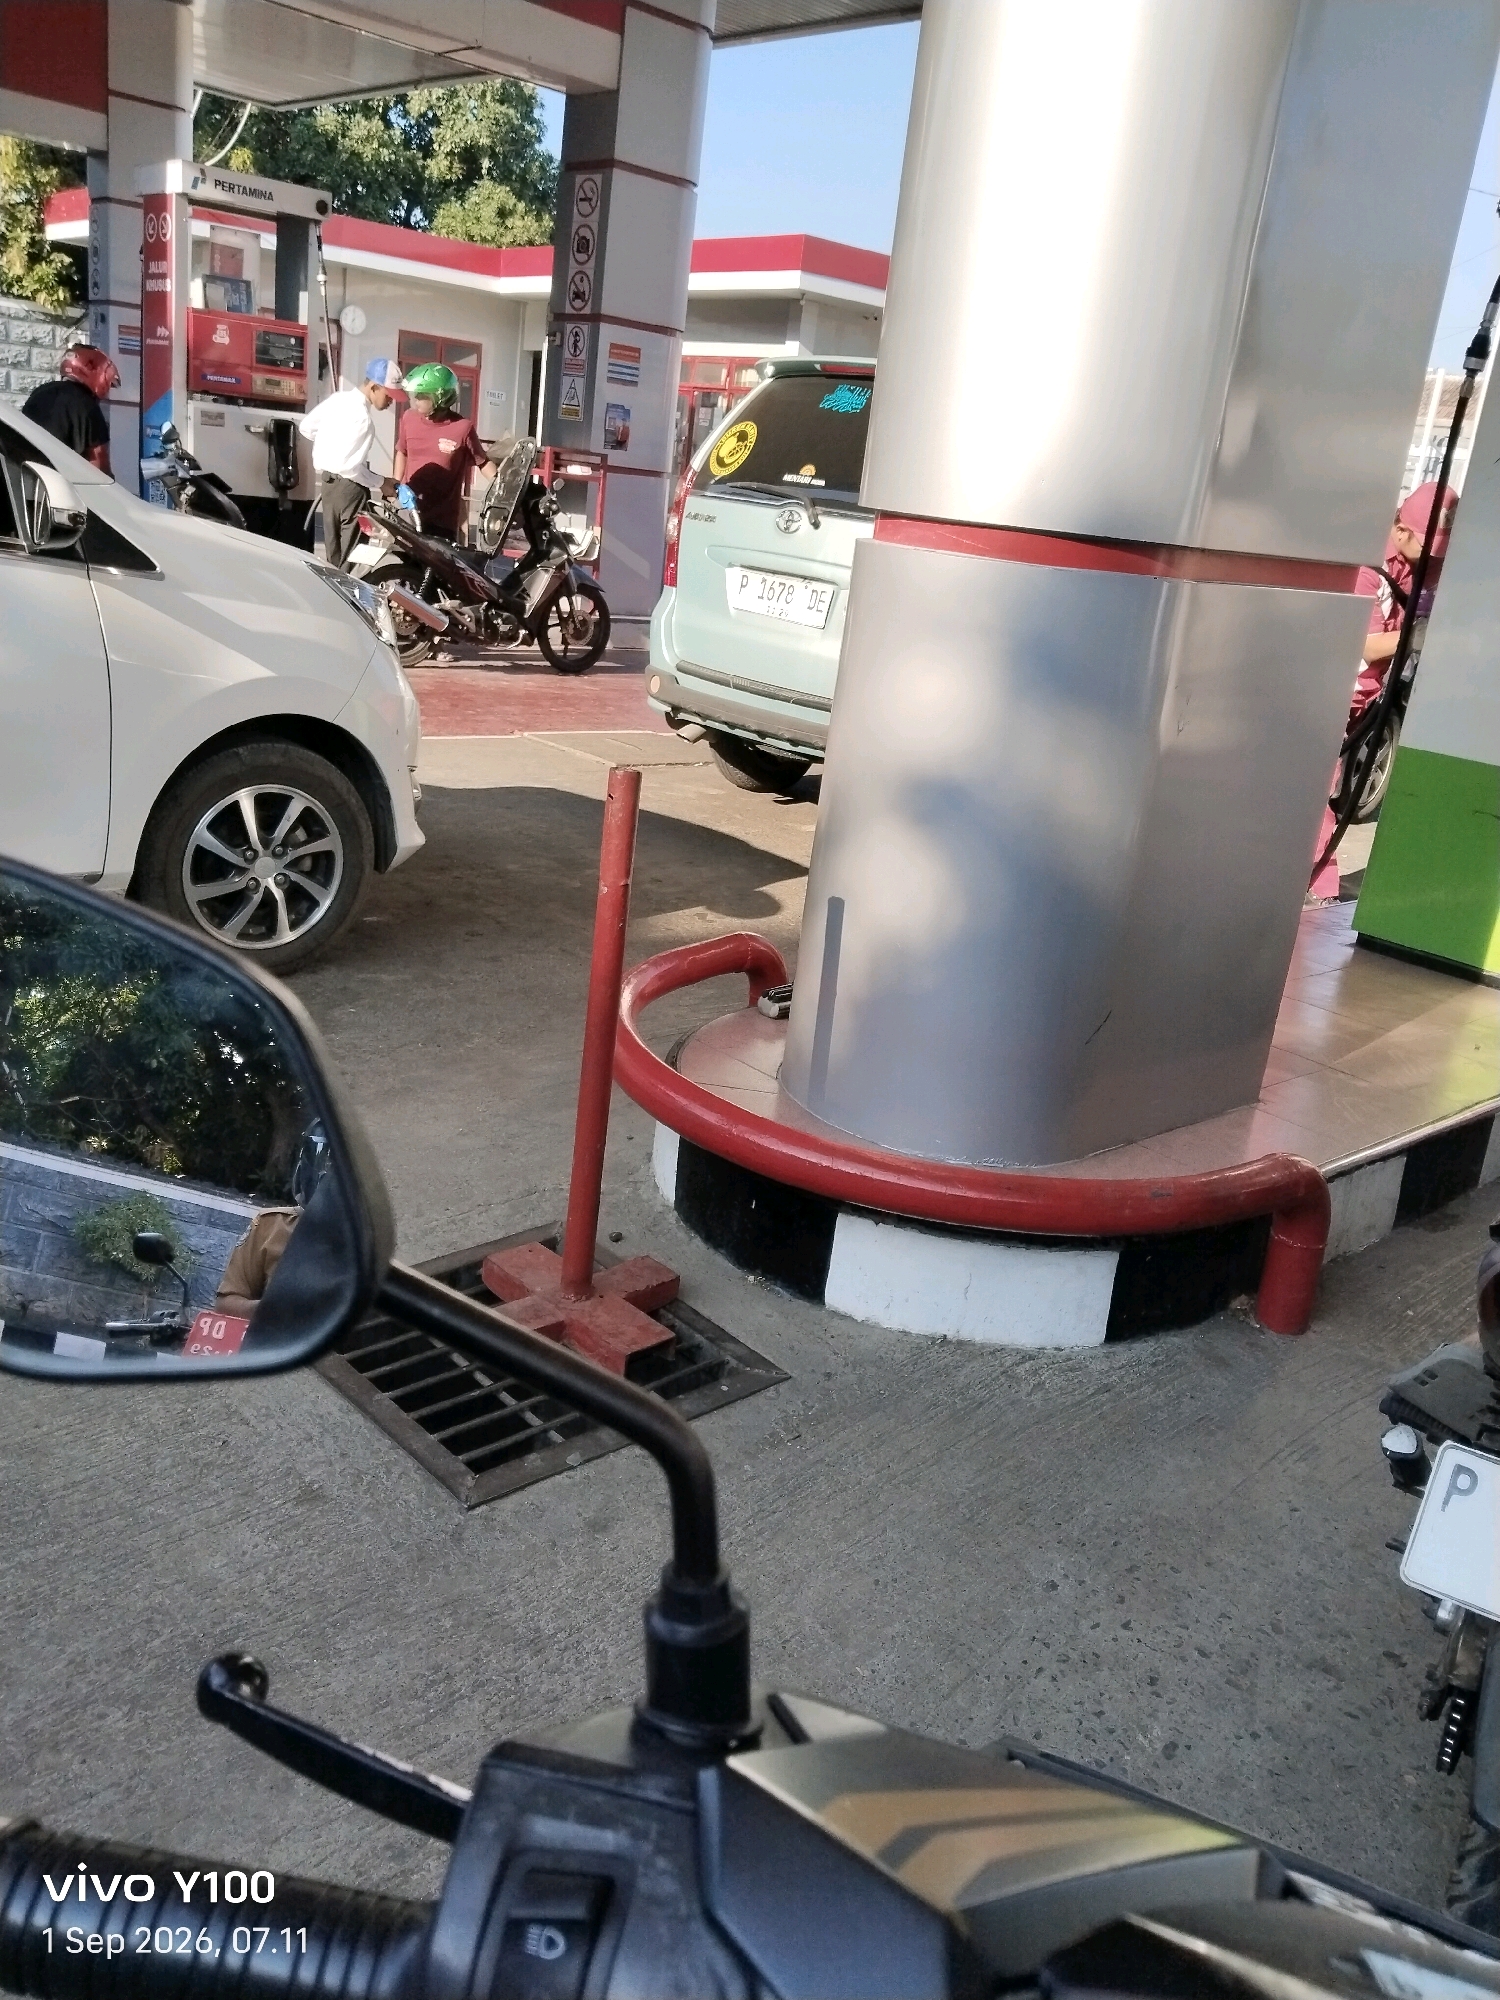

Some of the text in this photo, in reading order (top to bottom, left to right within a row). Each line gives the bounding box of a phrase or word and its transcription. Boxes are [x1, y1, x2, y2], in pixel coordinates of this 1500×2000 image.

[213, 178, 275, 202] PERTAMINA
[738, 574, 828, 613] P 1678 DE
[1440, 1463, 1479, 1513] P
